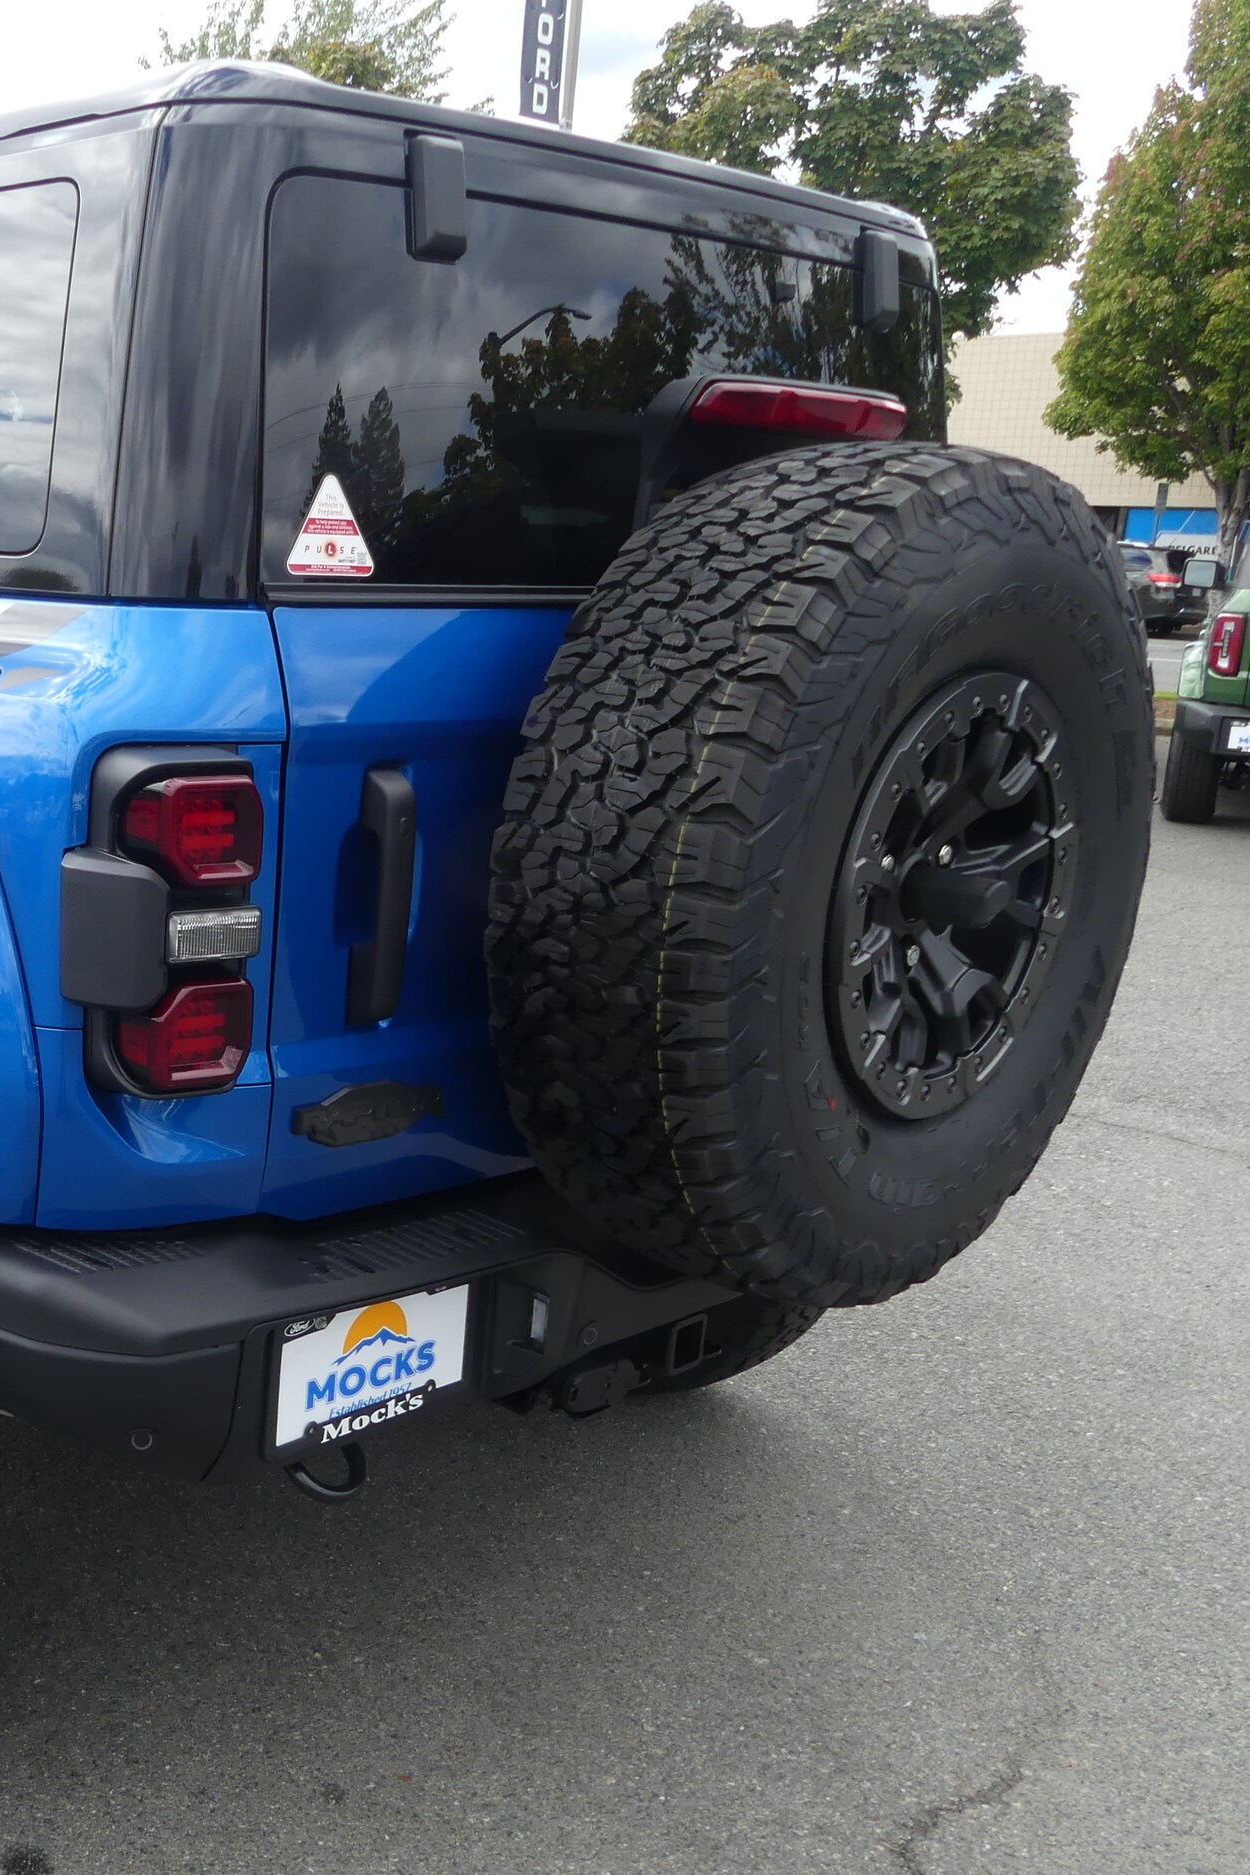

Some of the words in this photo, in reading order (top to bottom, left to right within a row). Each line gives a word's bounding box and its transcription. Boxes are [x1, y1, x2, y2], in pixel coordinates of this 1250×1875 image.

[532, 0, 554, 115] ORD
[304, 544, 356, 555] PULSE
[305, 1340, 436, 1412] MOCKS
[321, 1393, 424, 1444] Mock's
